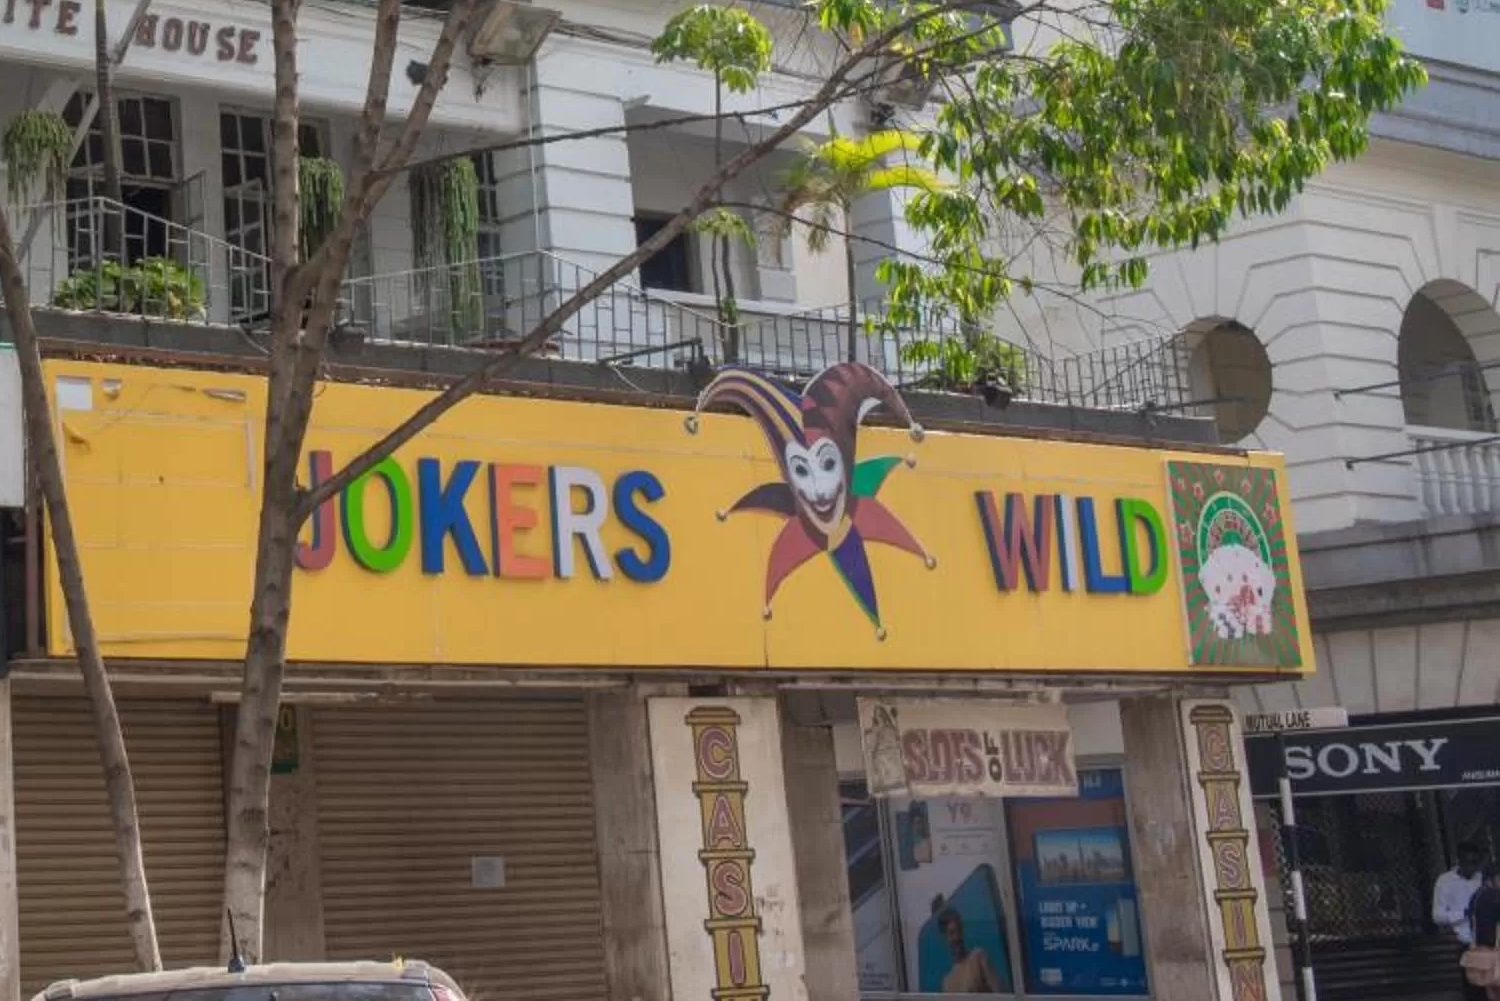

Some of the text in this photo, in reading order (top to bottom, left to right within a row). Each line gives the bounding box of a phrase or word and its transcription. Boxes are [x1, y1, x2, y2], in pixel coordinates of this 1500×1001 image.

[134, 14, 261, 64] HOUSE
[294, 450, 1169, 595] JOKERS WILD
[1002, 730, 1077, 786] LUCK
[1284, 737, 1448, 780] SONY
